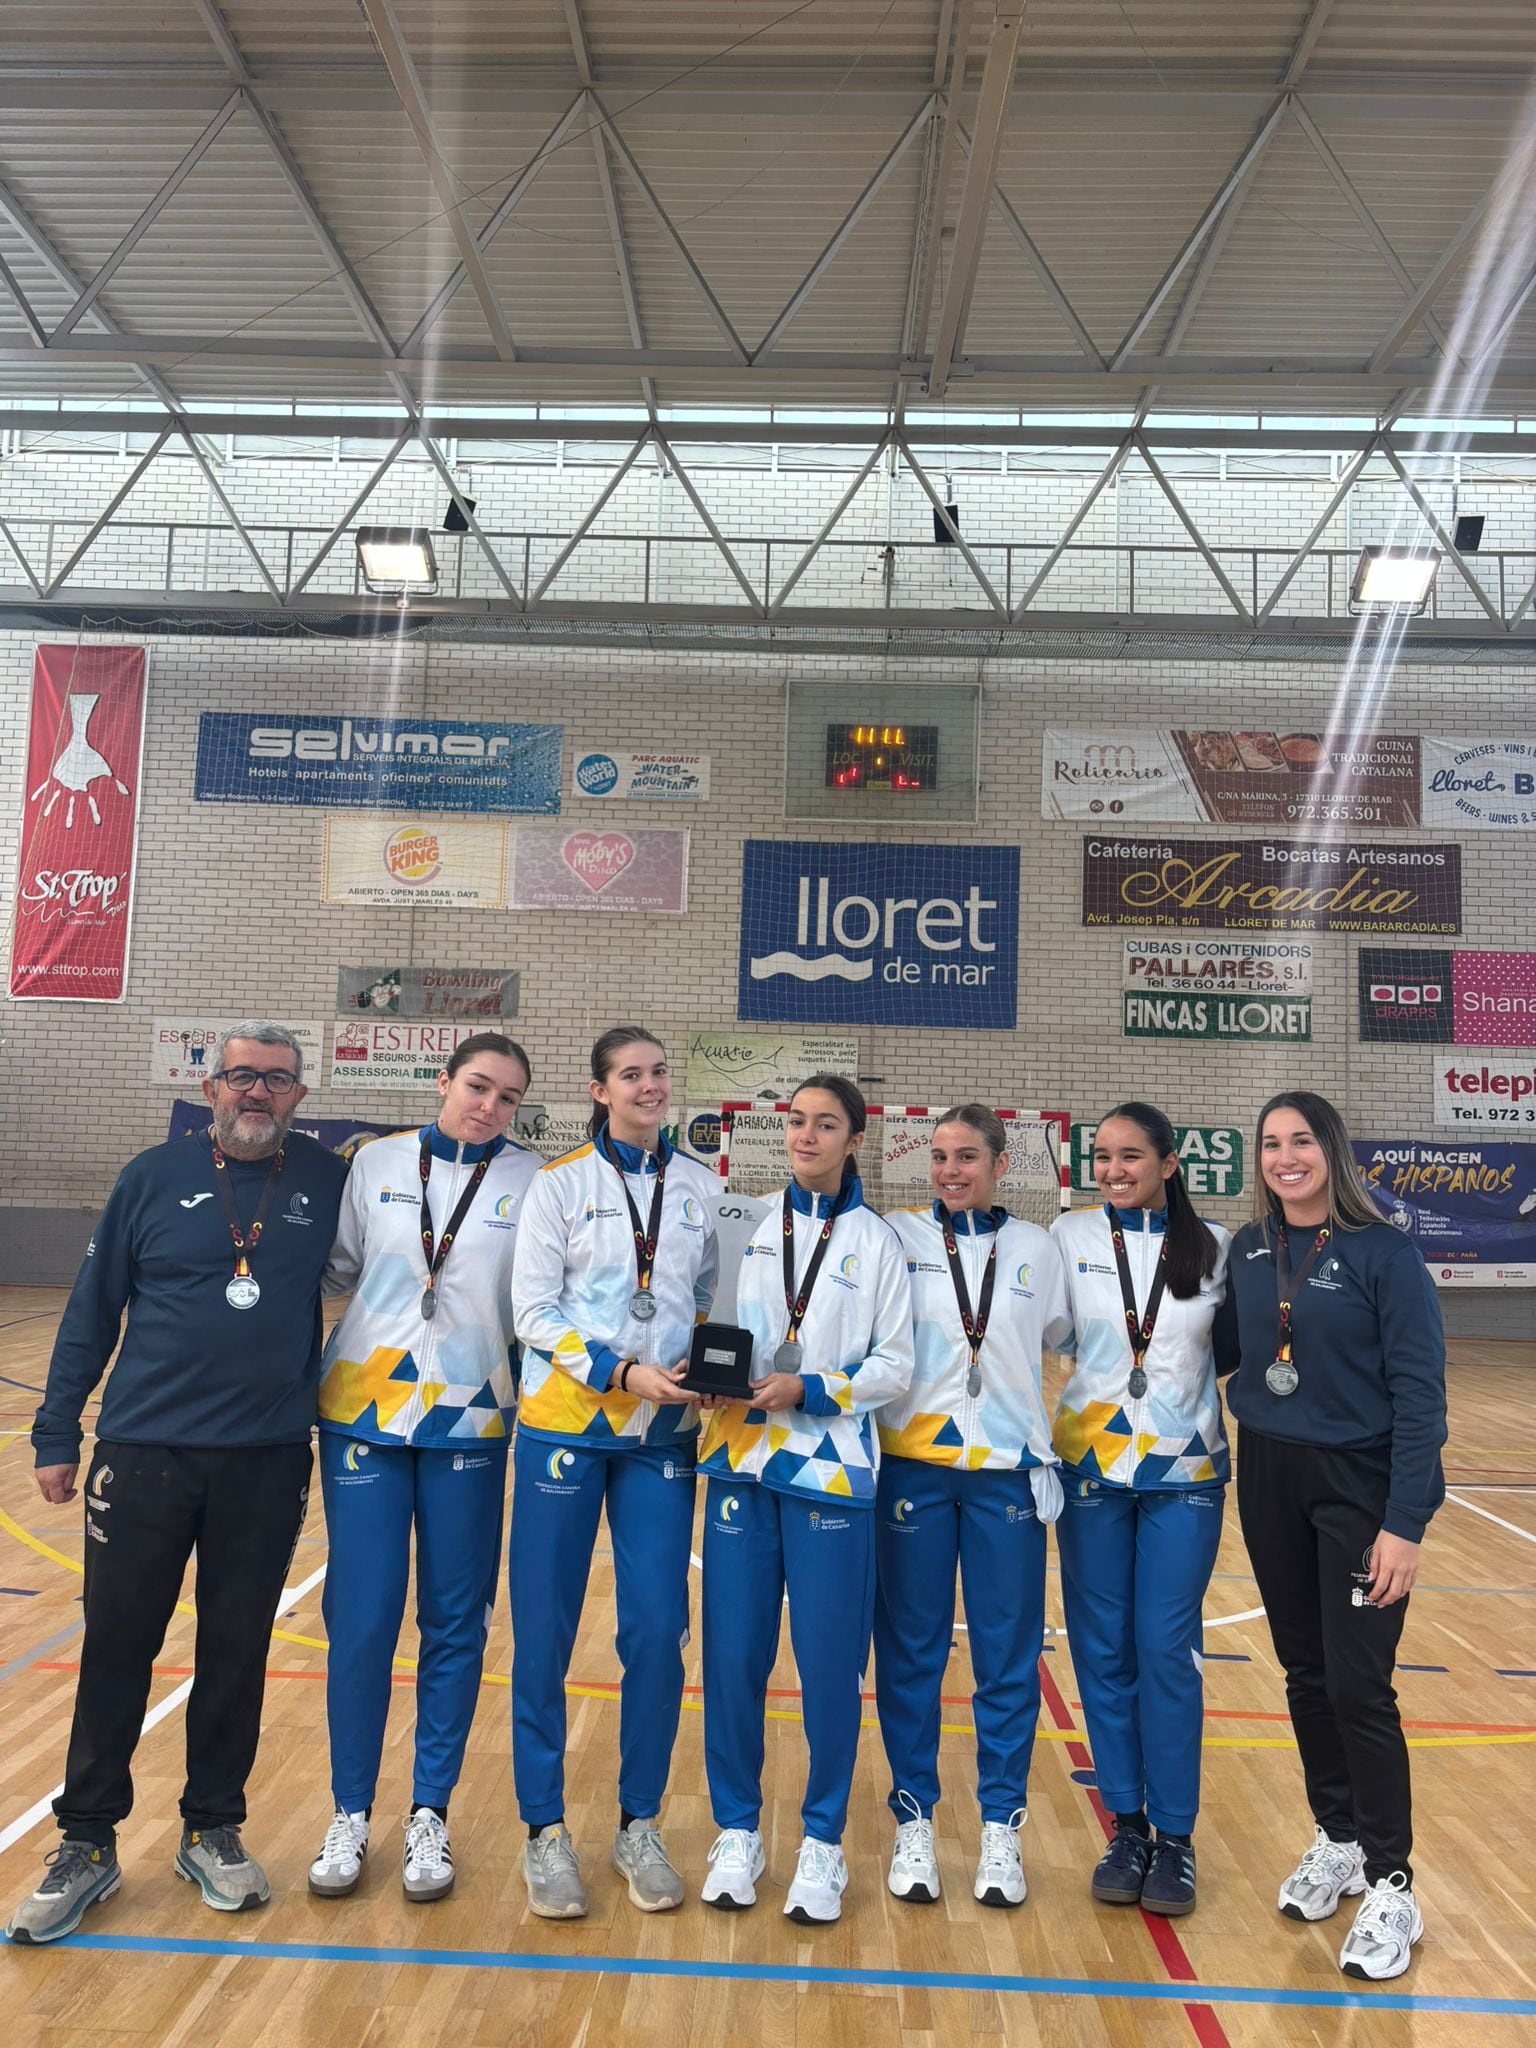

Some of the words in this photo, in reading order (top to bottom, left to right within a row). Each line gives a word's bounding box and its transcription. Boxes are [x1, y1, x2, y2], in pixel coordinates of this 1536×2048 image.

[249, 720, 510, 762] selvimar
[1377, 741, 1414, 751] CUINA
[353, 753, 395, 763] SERVEIS
[397, 755, 452, 765] INTEGRALS
[455, 757, 465, 765] DE
[471, 757, 508, 766] NETEJA
[833, 752, 862, 765] LOC.
[899, 753, 934, 767] VISIT.
[1332, 753, 1414, 764] TRADICIONAL
[1455, 744, 1496, 765] CERVESES
[1504, 744, 1525, 754] VINS
[249, 767, 287, 778] Hotels
[295, 770, 374, 782] apartaments
[382, 773, 431, 783] oficines
[439, 775, 508, 786] comunitats
[642, 764, 681, 775] WATER
[1054, 760, 1167, 785] Relicario
[1352, 766, 1414, 777] CATALANA
[376, 799, 408, 807] (GIRONA)
[1217, 791, 1239, 799] C/NA
[1241, 792, 1280, 801] MARINA,
[1282, 792, 1288, 801] 3
[1296, 793, 1320, 802] 17310
[1321, 794, 1356, 803] LLORET
[1358, 795, 1370, 803] DE
[1372, 796, 1392, 804] MAR
[1288, 805, 1382, 820] 972.365.301
[1455, 798, 1481, 818] BEERS
[1489, 812, 1518, 824] WINES
[1521, 813, 1530, 823] &
[390, 836, 438, 857] BURGER
[1088, 842, 1173, 859] Cafeteria
[390, 847, 440, 873] KING
[1262, 846, 1341, 863] Bocatas
[1346, 848, 1445, 865] Artesanos
[1121, 852, 1419, 914] Arcadia
[348, 888, 384, 896] ABIERTO
[391, 889, 414, 897] OPEN
[415, 889, 429, 897] 365
[431, 890, 450, 898] DIAS
[457, 890, 479, 899] DAYS
[641, 897, 663, 905] DAYS
[797, 877, 997, 951] lloret
[1087, 913, 1112, 924] Avd.
[1117, 914, 1152, 926] Josep
[1156, 915, 1178, 926] Pla,
[1182, 916, 1200, 926] s/n
[1224, 917, 1268, 928] LLORET
[1272, 919, 1287, 928] DE
[1291, 920, 1316, 929] MAR
[1329, 921, 1456, 932] WWW.BARARCADIA.ES
[1126, 941, 1182, 954] CUBAS
[1186, 943, 1191, 954] i
[1195, 943, 1312, 958] CONTENIDORS
[17, 963, 119, 977] www.sttrop.com
[883, 956, 921, 983] de
[931, 963, 995, 985] mar
[1129, 956, 1279, 982] PALLARÉS,
[1283, 963, 1307, 980] s.l.
[423, 970, 502, 992] Bowling
[1144, 977, 1168, 988] Tel.
[1172, 979, 1191, 988] 36
[1194, 979, 1214, 989] 60
[1217, 980, 1236, 989] 44
[423, 992, 503, 1016] Lloret
[1126, 999, 1207, 1032] FINCAS
[1218, 1002, 1310, 1034] LLORET
[373, 1025, 480, 1052] ESTREL
[802, 1040, 844, 1048] Especialitat
[690, 1035, 757, 1061] Acuario
[803, 1049, 837, 1057] arrossos,
[373, 1053, 417, 1063] SEGUROS
[424, 1054, 451, 1064] ASSE
[334, 1067, 410, 1077] ASSESSORIA
[886, 1115, 908, 1123] aire
[911, 1116, 939, 1125] cond
[1452, 1107, 1482, 1120] Tel.
[1488, 1108, 1519, 1121] 972
[1525, 1109, 1536, 1121] 3
[891, 1130, 911, 1144] Tel.
[1080, 1126, 1233, 1161] FAS
[1371, 1147, 1416, 1164] AQUÍ
[1420, 1152, 1481, 1164] NACEN
[1080, 1160, 1233, 1193] LET
[1357, 1163, 1386, 1190] OS
[1393, 1163, 1516, 1198] HISPANOS
